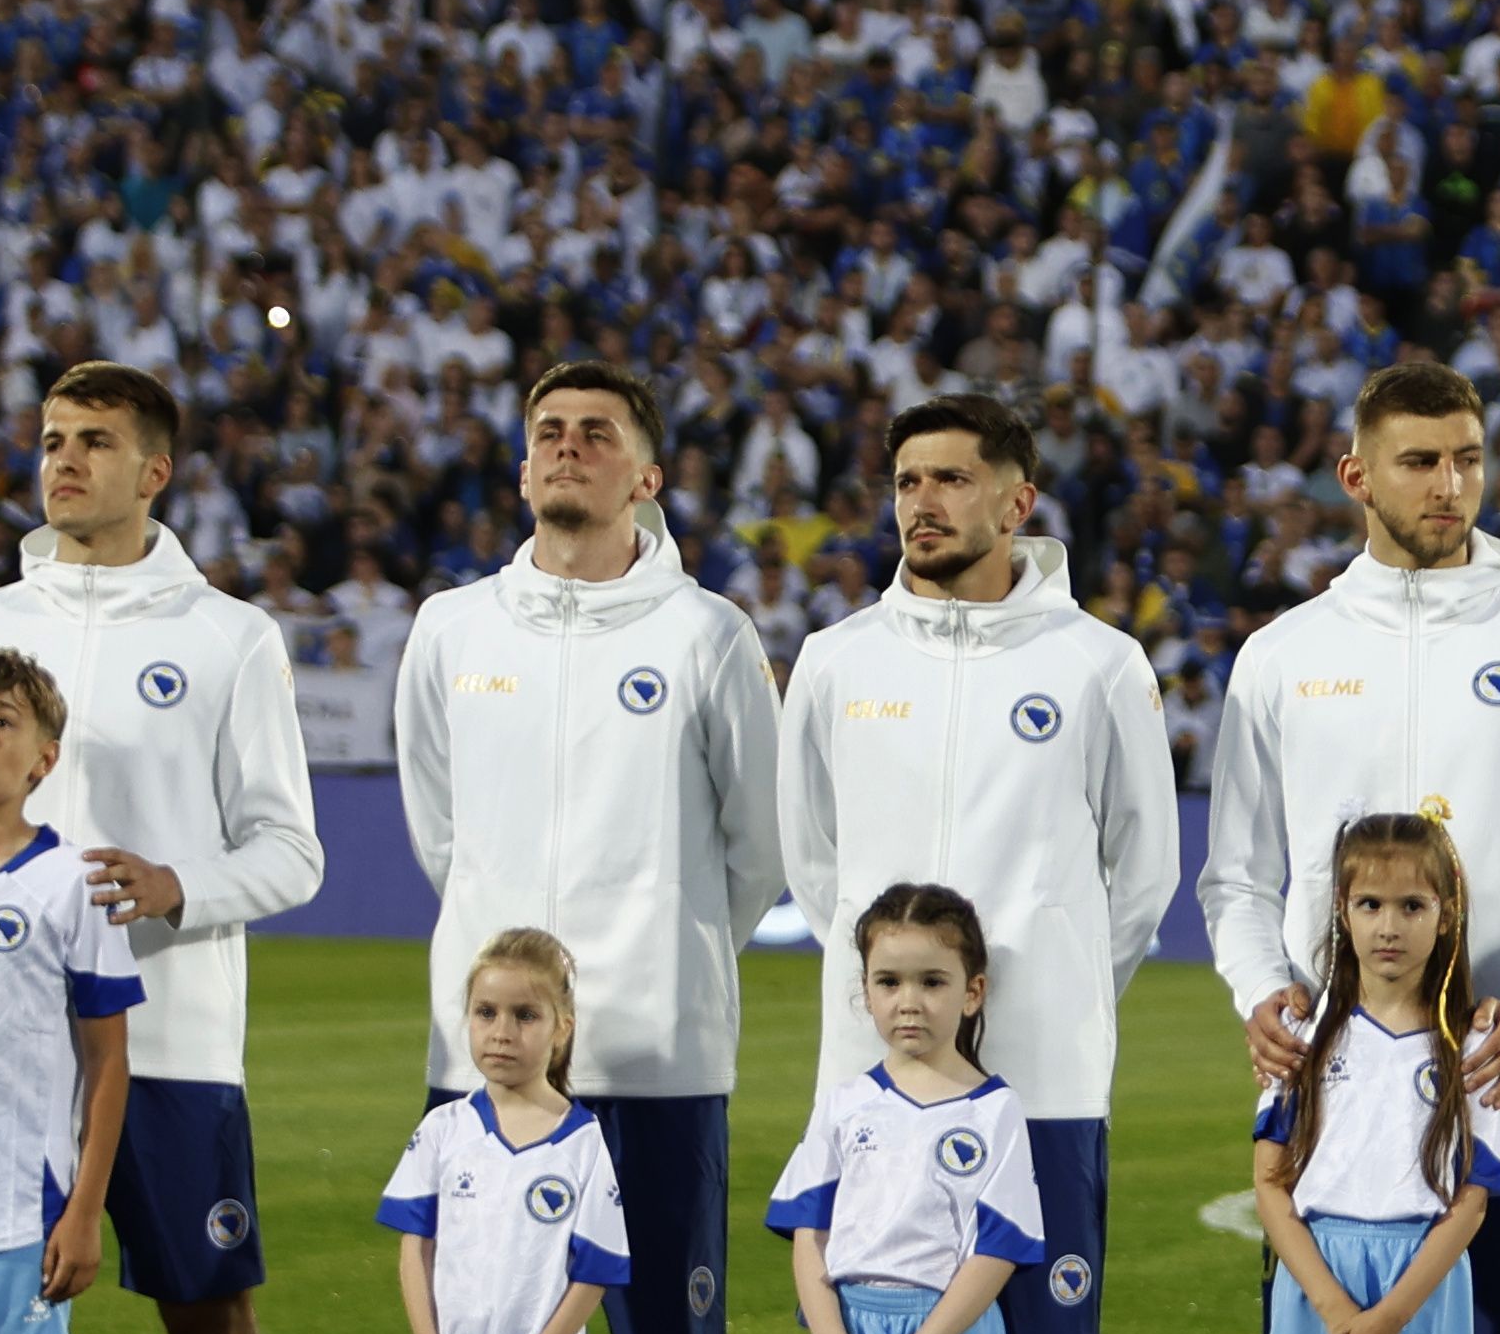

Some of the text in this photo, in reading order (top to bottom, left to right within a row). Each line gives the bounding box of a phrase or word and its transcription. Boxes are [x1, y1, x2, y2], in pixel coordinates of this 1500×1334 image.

[453, 674, 520, 693] KELME
[1297, 679, 1364, 697] KELME
[845, 700, 913, 719] KELME
